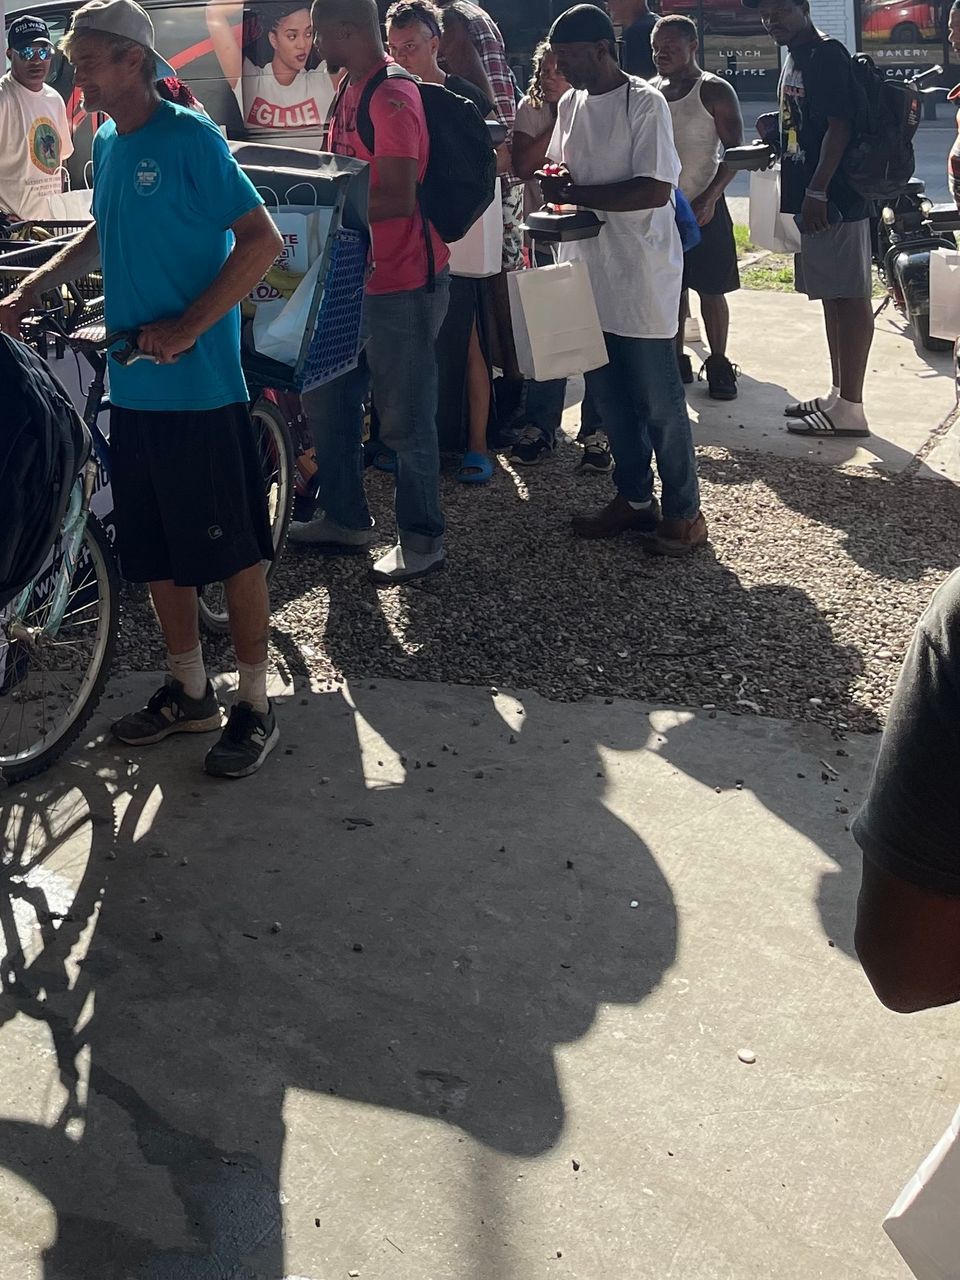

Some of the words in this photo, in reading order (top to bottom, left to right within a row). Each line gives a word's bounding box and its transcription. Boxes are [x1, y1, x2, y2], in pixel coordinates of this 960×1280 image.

[877, 49, 928, 57] BAKERY
[716, 68, 766, 76] COFFEE
[256, 103, 316, 128] GLUE
[281, 234, 298, 244] TE
